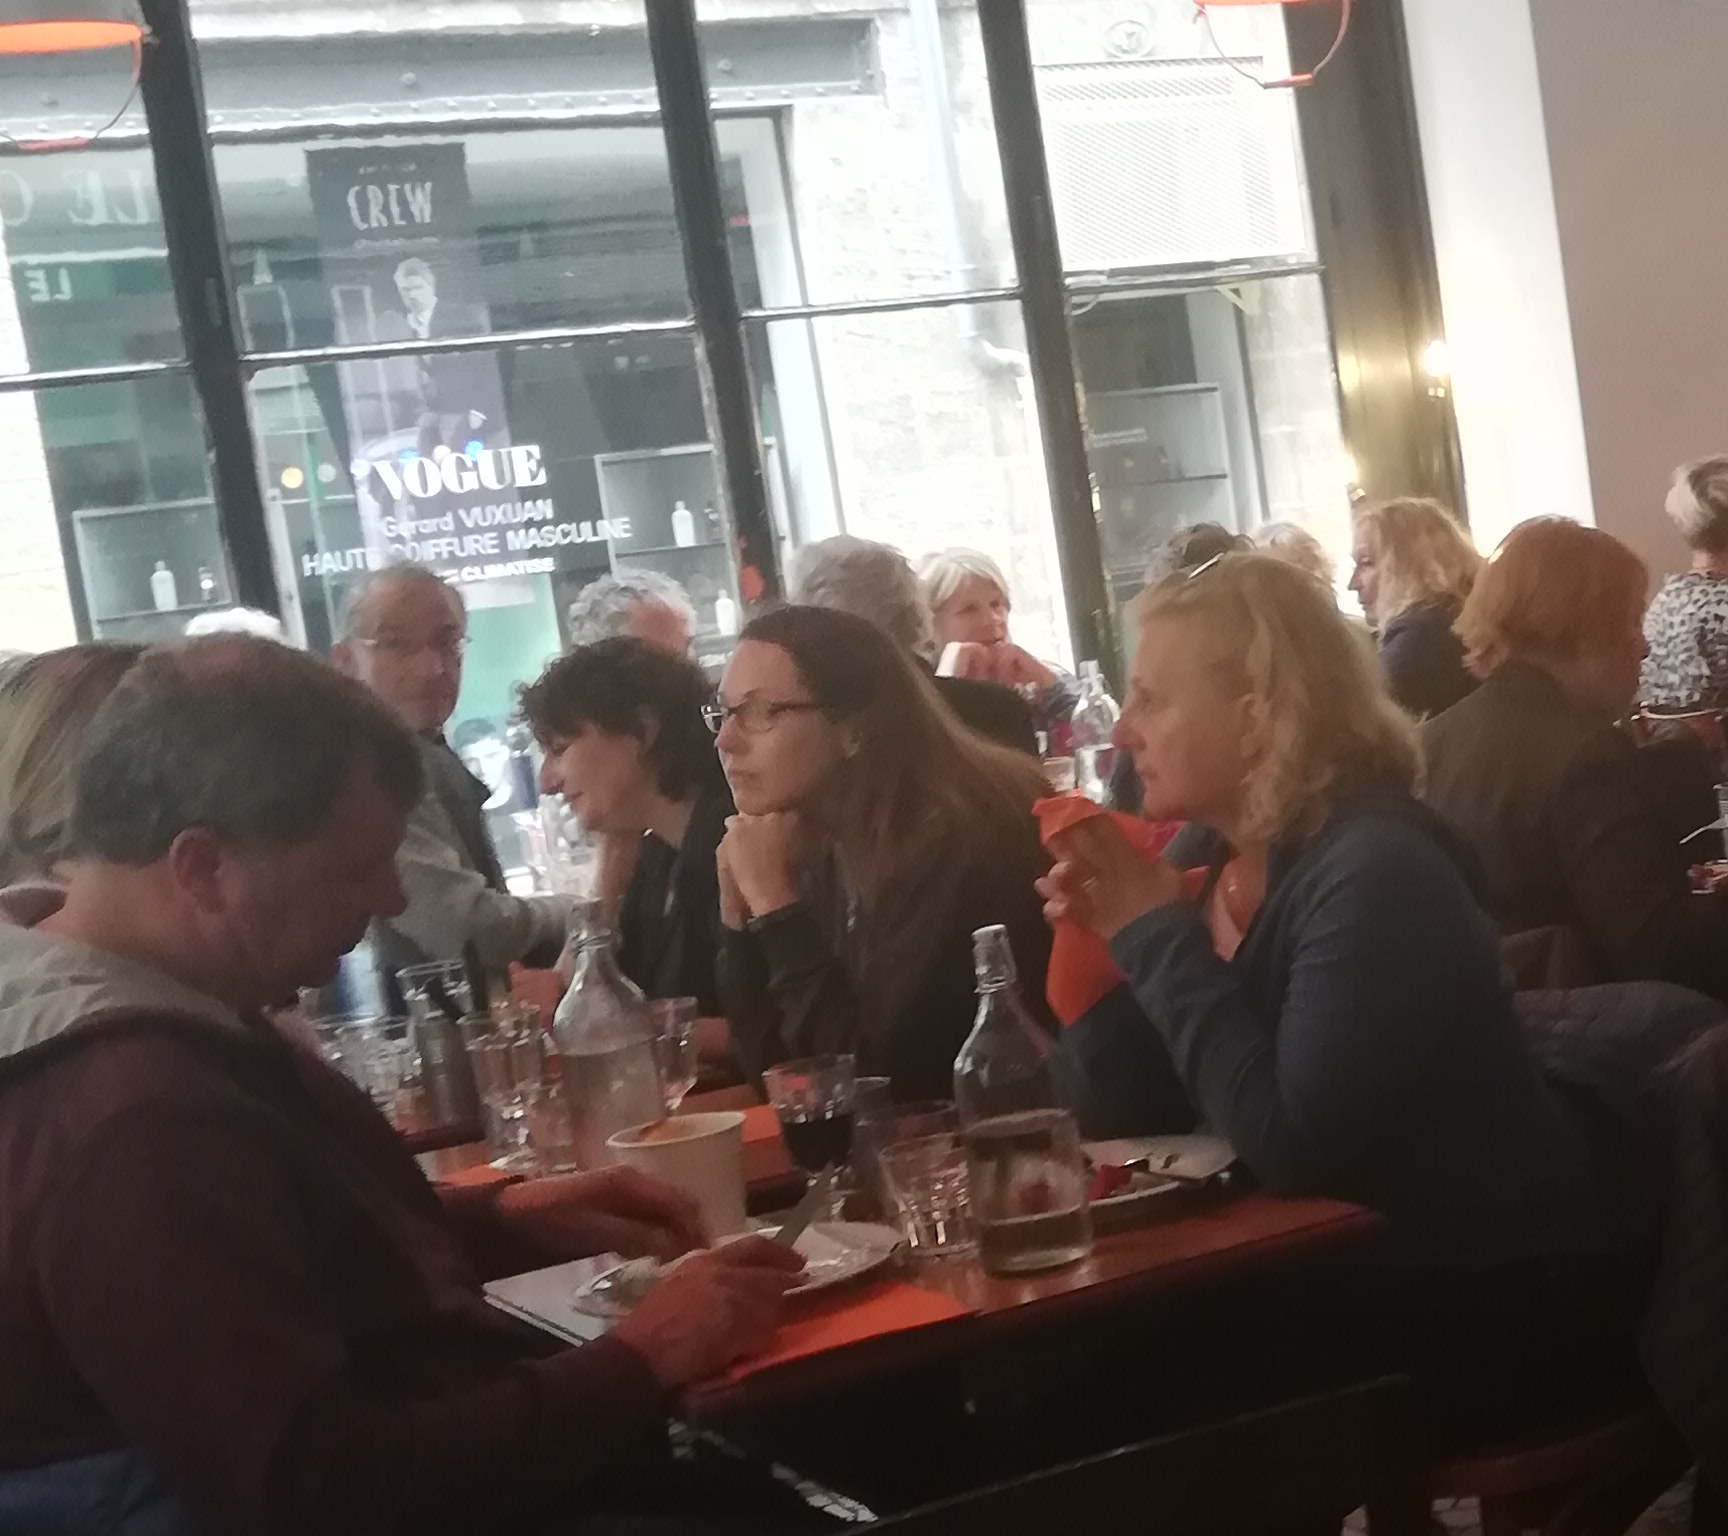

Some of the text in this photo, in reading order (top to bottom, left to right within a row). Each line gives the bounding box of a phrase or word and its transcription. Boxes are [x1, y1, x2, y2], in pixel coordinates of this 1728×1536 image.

[347, 181, 432, 230] CREW
[371, 444, 547, 500] VOGUE
[506, 516, 633, 552] MASCULINE
